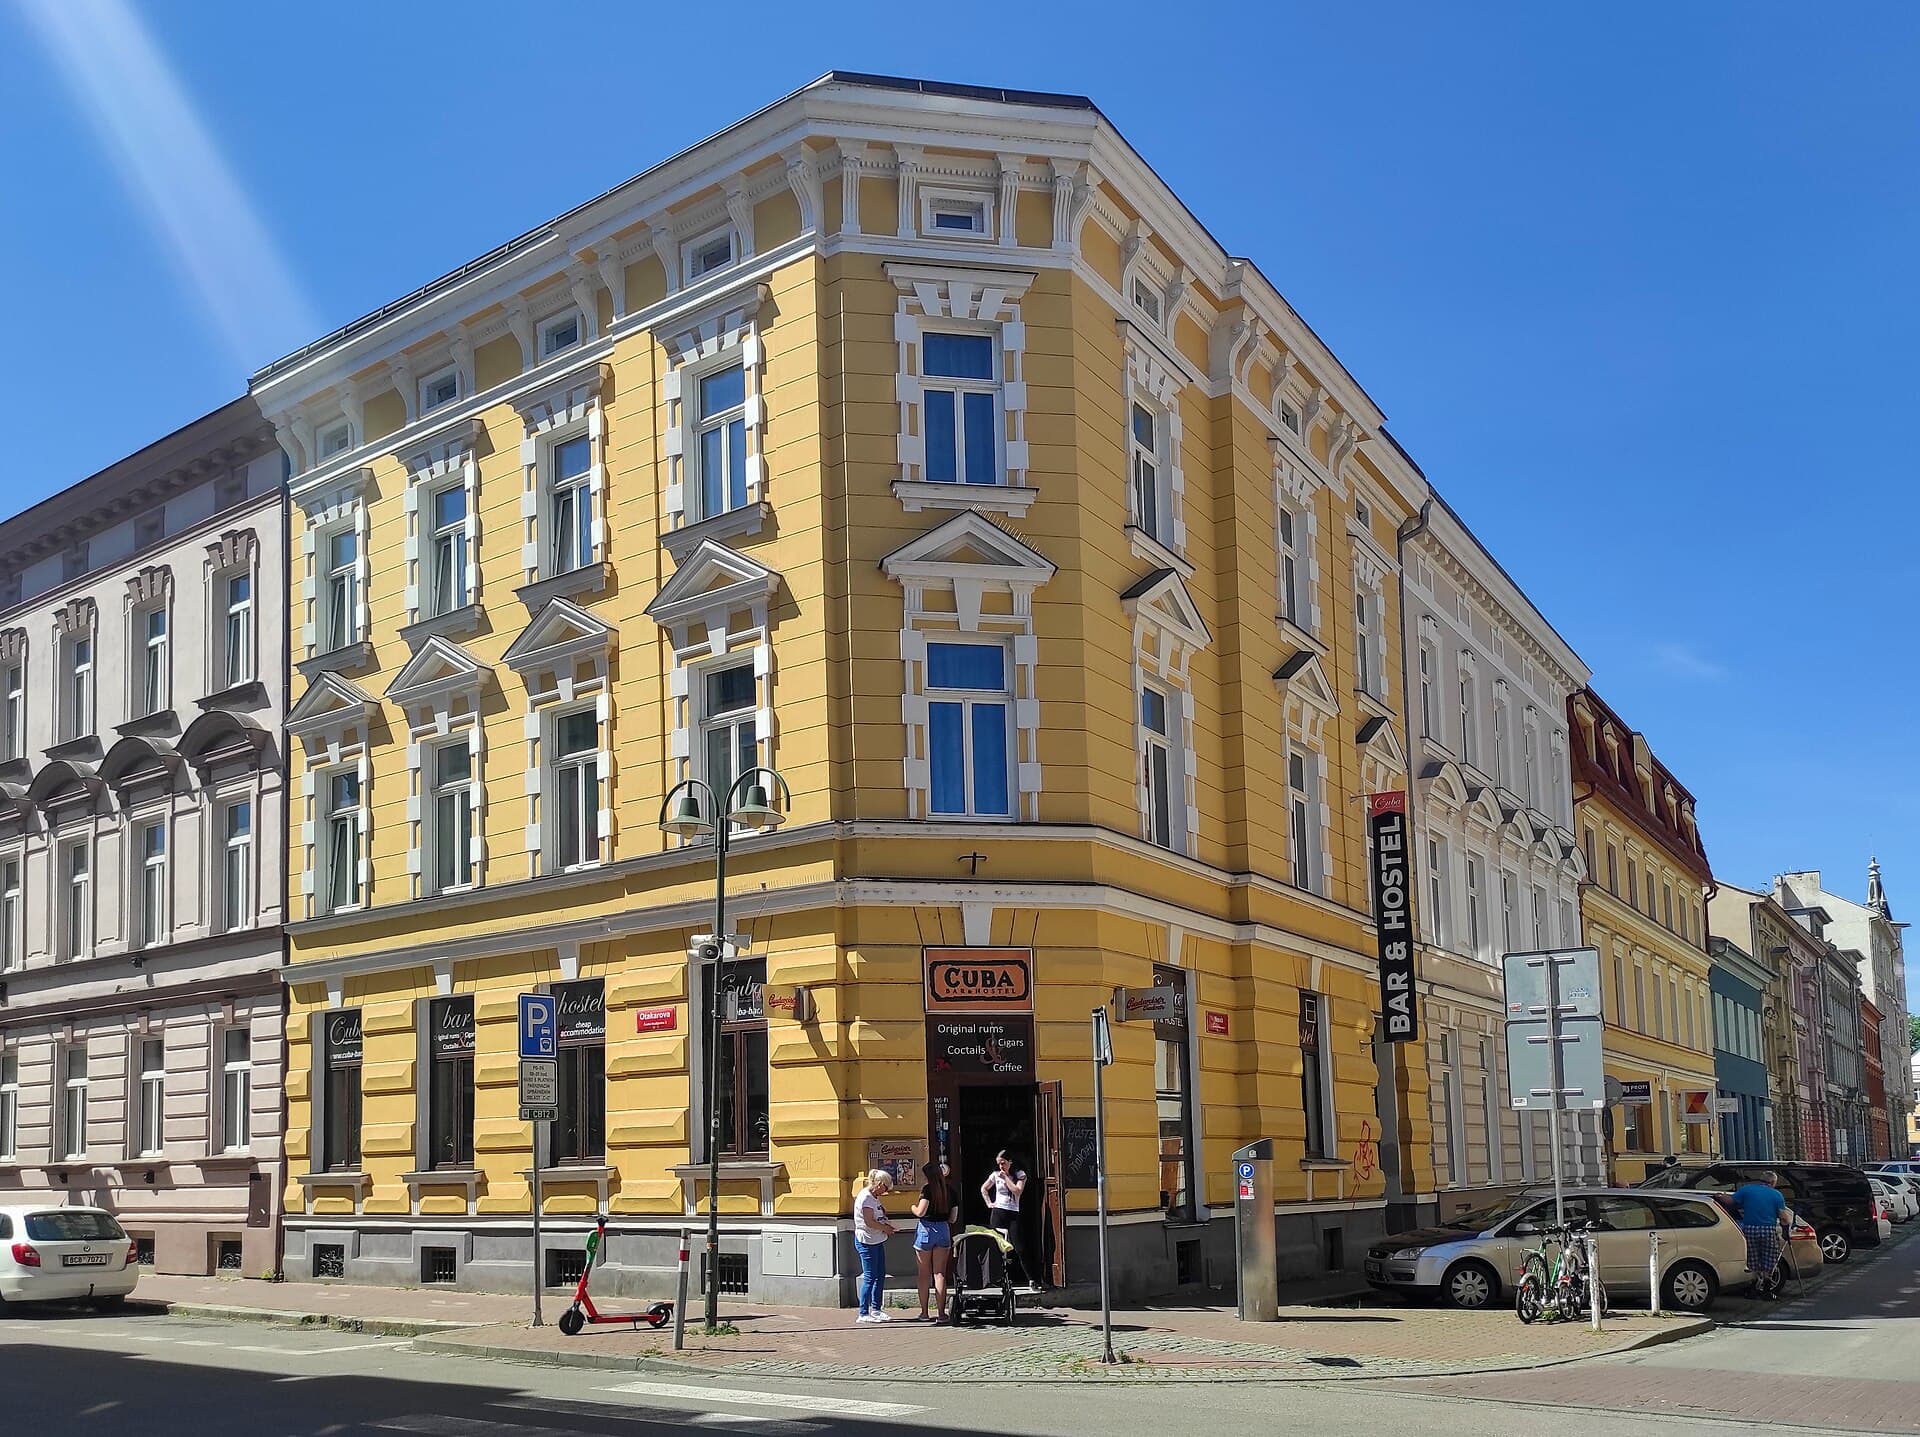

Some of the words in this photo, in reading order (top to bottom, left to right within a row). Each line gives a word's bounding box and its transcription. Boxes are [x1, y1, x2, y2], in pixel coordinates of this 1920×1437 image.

[1374, 796, 1401, 810] Cuba
[1379, 815, 1406, 930] HOSTEL
[1385, 941, 1407, 961] &
[944, 967, 1014, 988] CUBA
[557, 989, 604, 1016] hostel
[1387, 973, 1411, 1034] BAR
[442, 1004, 472, 1029] bar
[528, 1002, 549, 1038] P
[639, 1011, 671, 1020] Otakarova
[575, 1020, 592, 1028] cheap
[937, 1024, 976, 1035] Original
[978, 1025, 1004, 1033] rums
[560, 1025, 605, 1037] accommodatio
[997, 1038, 1024, 1048] Cigars
[947, 1045, 986, 1055] Coctails
[993, 1063, 1022, 1072] Coffee
[1242, 1165, 1251, 1176] P
